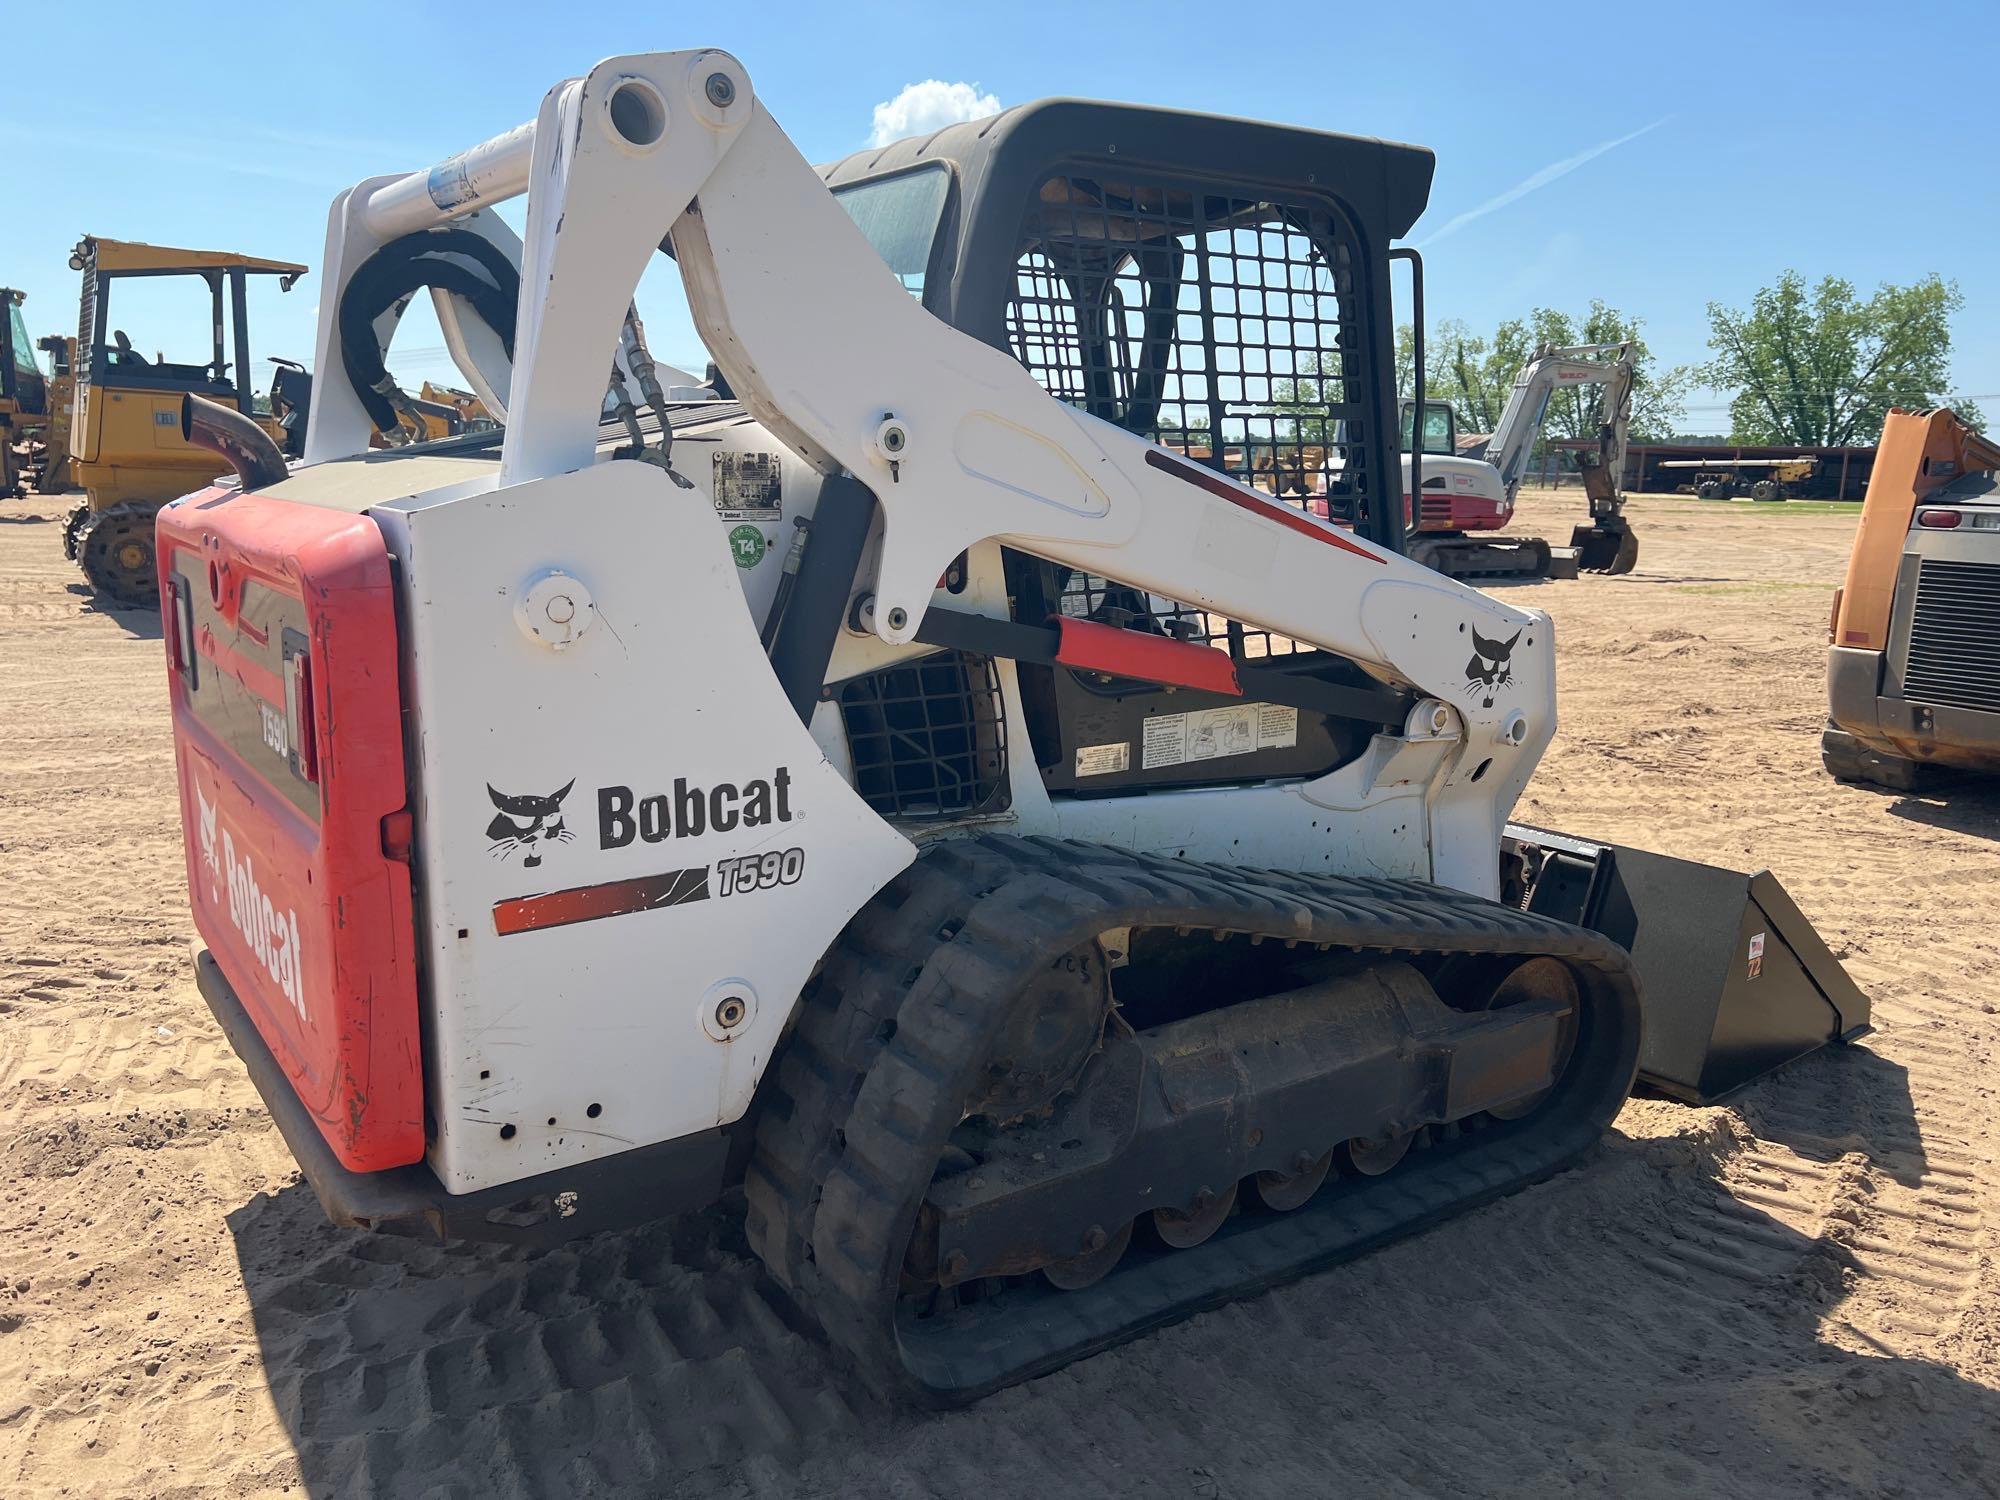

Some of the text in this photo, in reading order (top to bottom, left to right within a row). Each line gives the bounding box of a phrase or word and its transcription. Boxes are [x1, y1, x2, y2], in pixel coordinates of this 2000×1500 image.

[738, 539, 755, 554] T4
[262, 704, 288, 758] T590
[597, 766, 792, 850] Bobcat
[717, 847, 805, 897] T590
[222, 827, 307, 1022] Bobcat
[1747, 957, 1761, 978] 72
